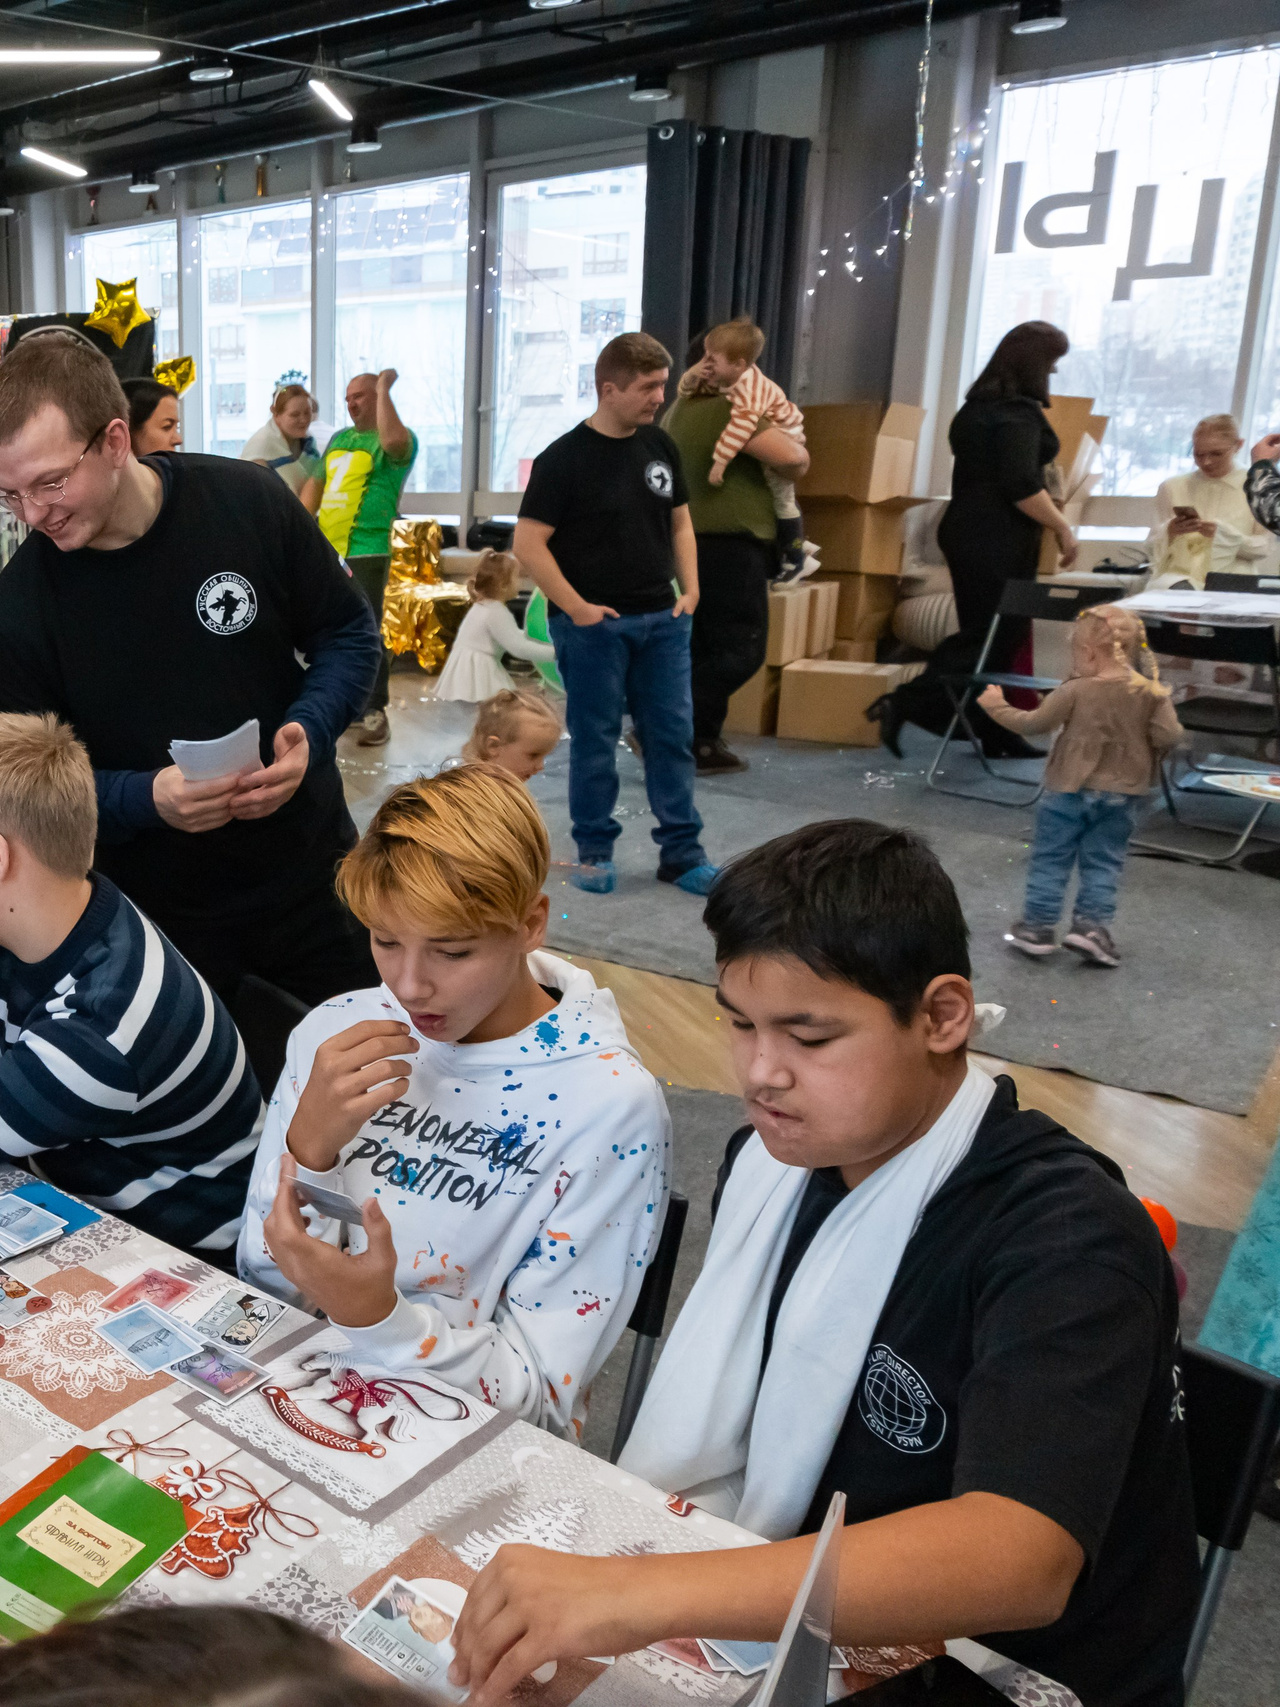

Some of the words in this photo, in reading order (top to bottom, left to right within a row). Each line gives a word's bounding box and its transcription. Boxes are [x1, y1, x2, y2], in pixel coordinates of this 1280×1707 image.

[199, 578, 219, 611] РУССКАЯ
[220, 574, 252, 594] ОБЩИНА
[370, 1100, 546, 1178] ENOMENAL
[344, 1136, 501, 1211] POSITION
[887, 1354, 932, 1406] DIRECTOR
[895, 1434, 924, 1448] NASA
[44, 1523, 85, 1553] ПРАВИЛА
[83, 1548, 110, 1568] ИГРЫ
[65, 1520, 77, 1530] ЗА
[77, 1527, 112, 1550] БОРТОМ!
